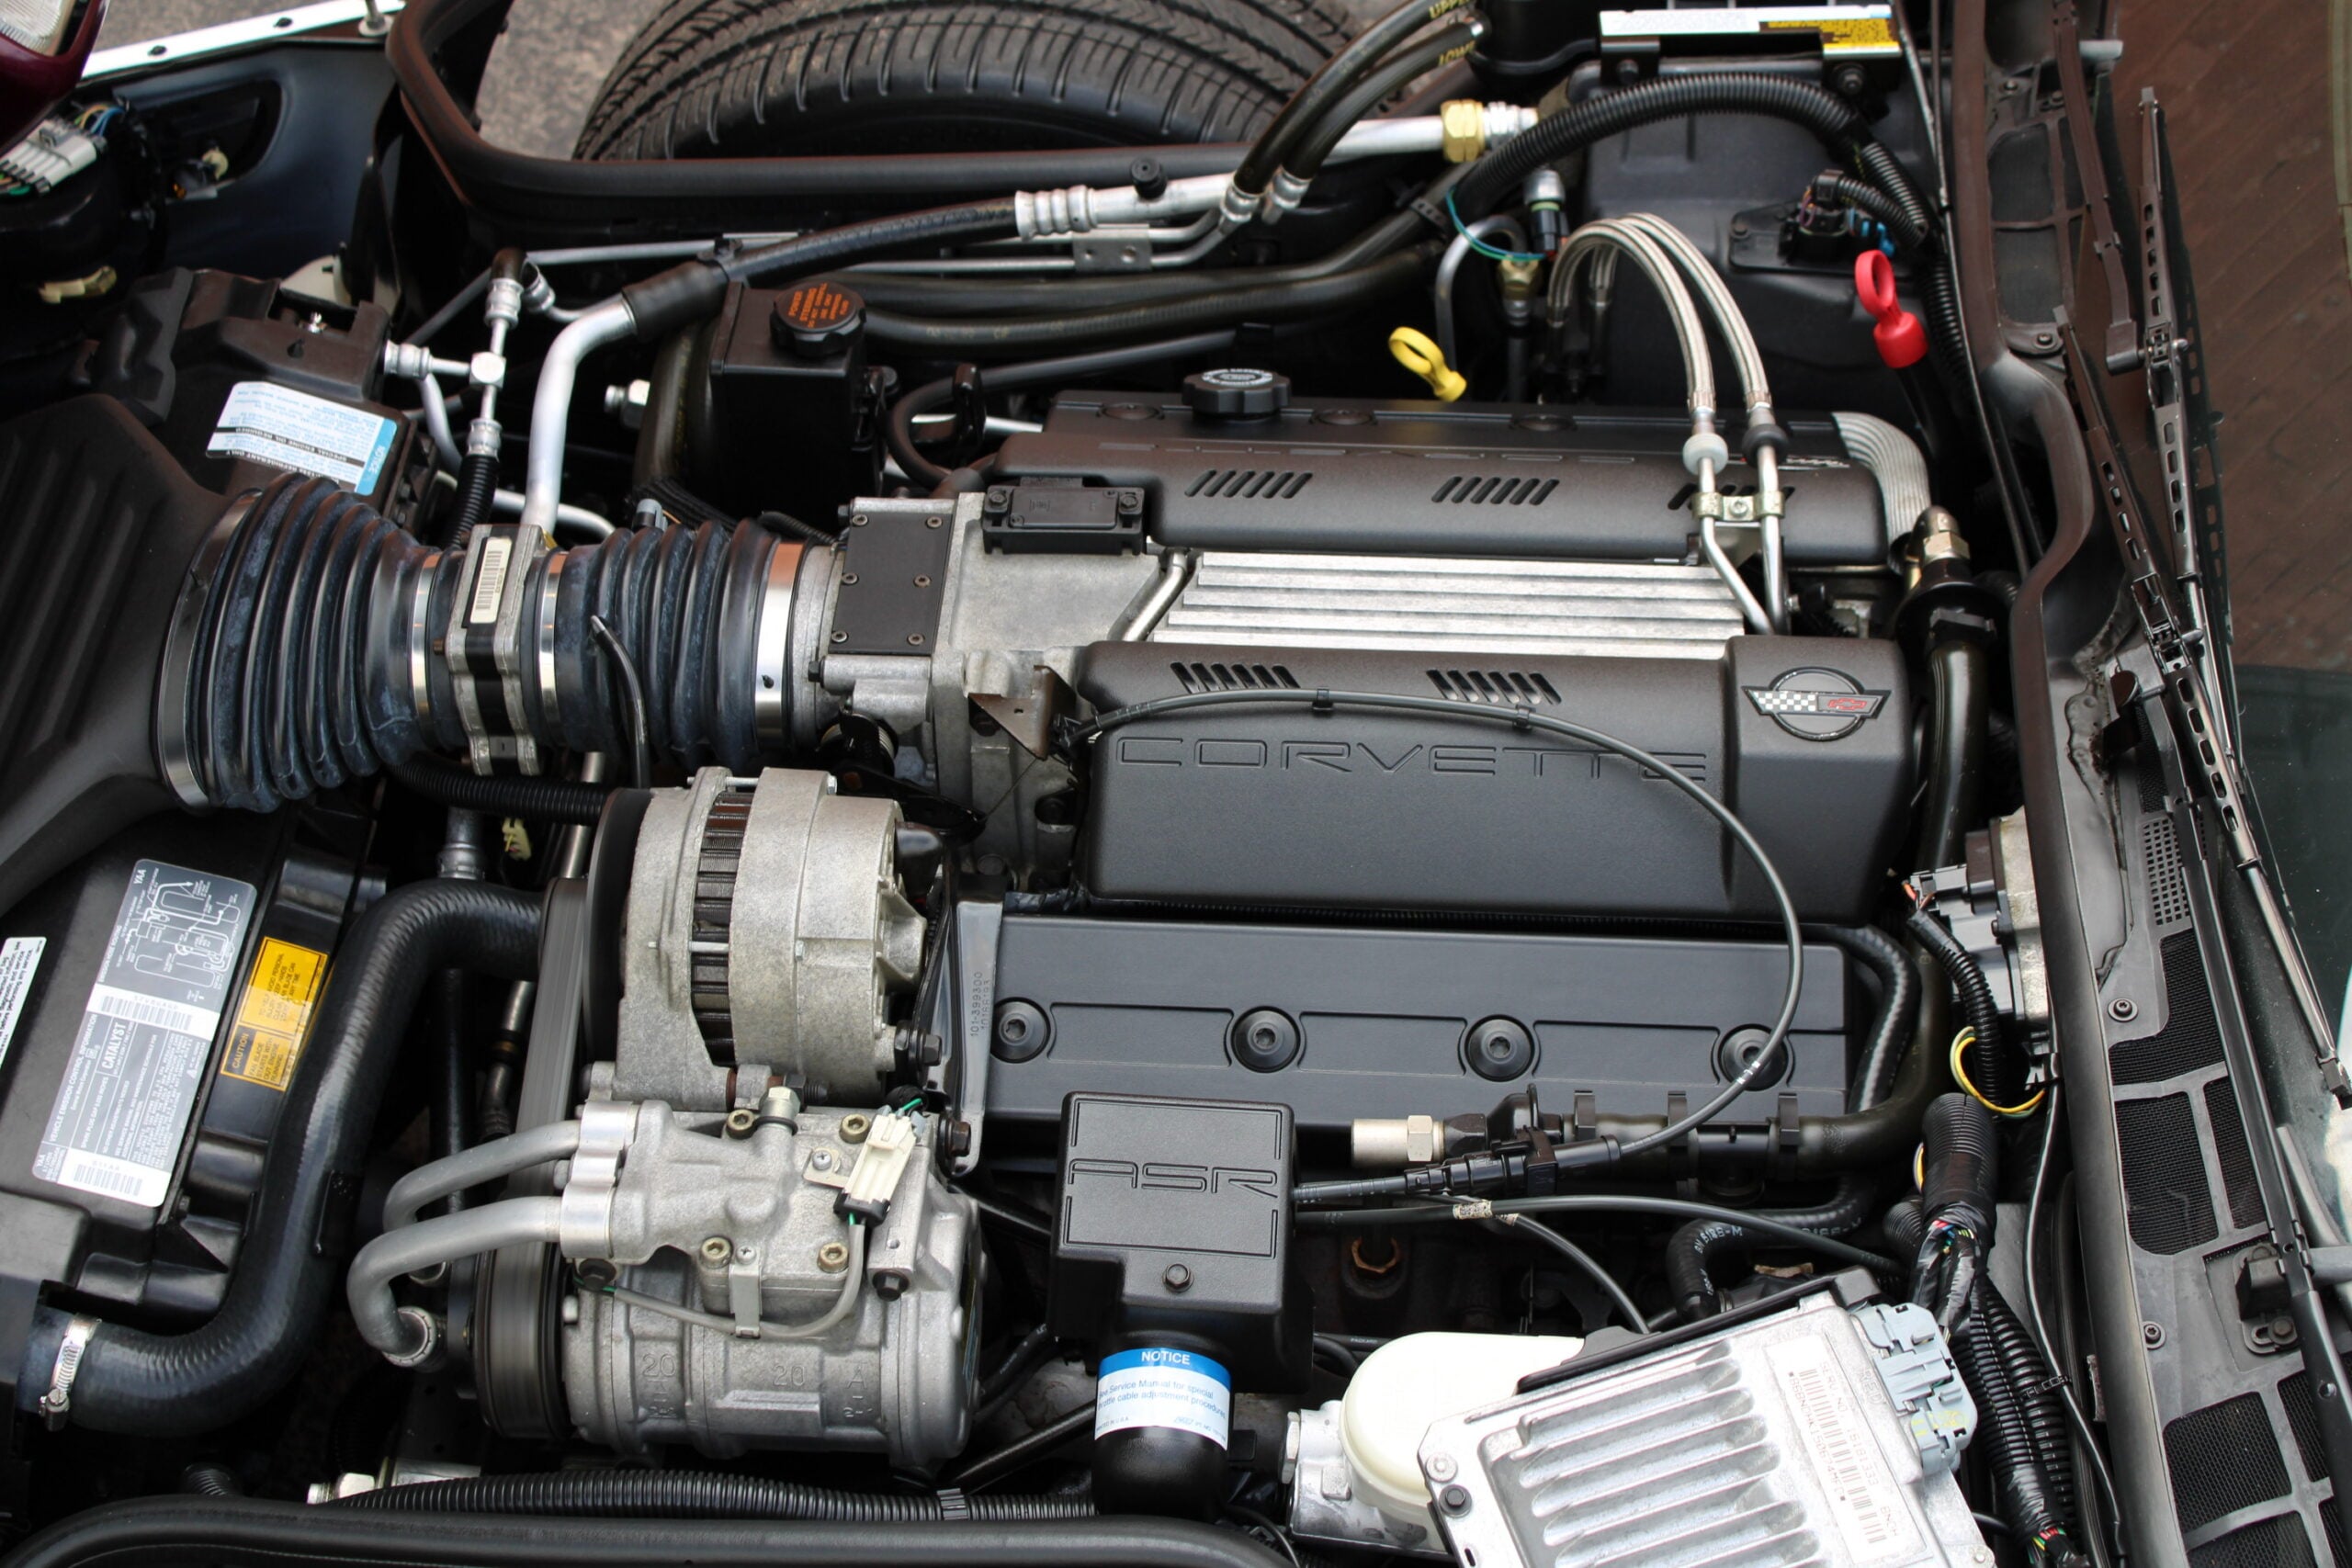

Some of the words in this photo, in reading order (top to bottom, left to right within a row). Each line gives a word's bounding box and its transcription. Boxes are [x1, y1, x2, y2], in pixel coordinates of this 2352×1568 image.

[1114, 734, 1707, 784] CORVETTE
[133, 867, 146, 885] YAA
[101, 1021, 126, 1069] CATALYST
[232, 1032, 248, 1068] CAUTION
[1068, 1158, 1278, 1199] ASR
[642, 1352, 676, 1378] 20
[1141, 1350, 1190, 1366] NOTICE
[773, 1364, 806, 1387] 20
[1110, 1382, 1136, 1393] Service
[1139, 1379, 1170, 1388] Manual
[1173, 1381, 1184, 1390] for
[1187, 1385, 1214, 1399] special
[1117, 1393, 1139, 1402] cable
[1141, 1393, 1189, 1402] adjustment
